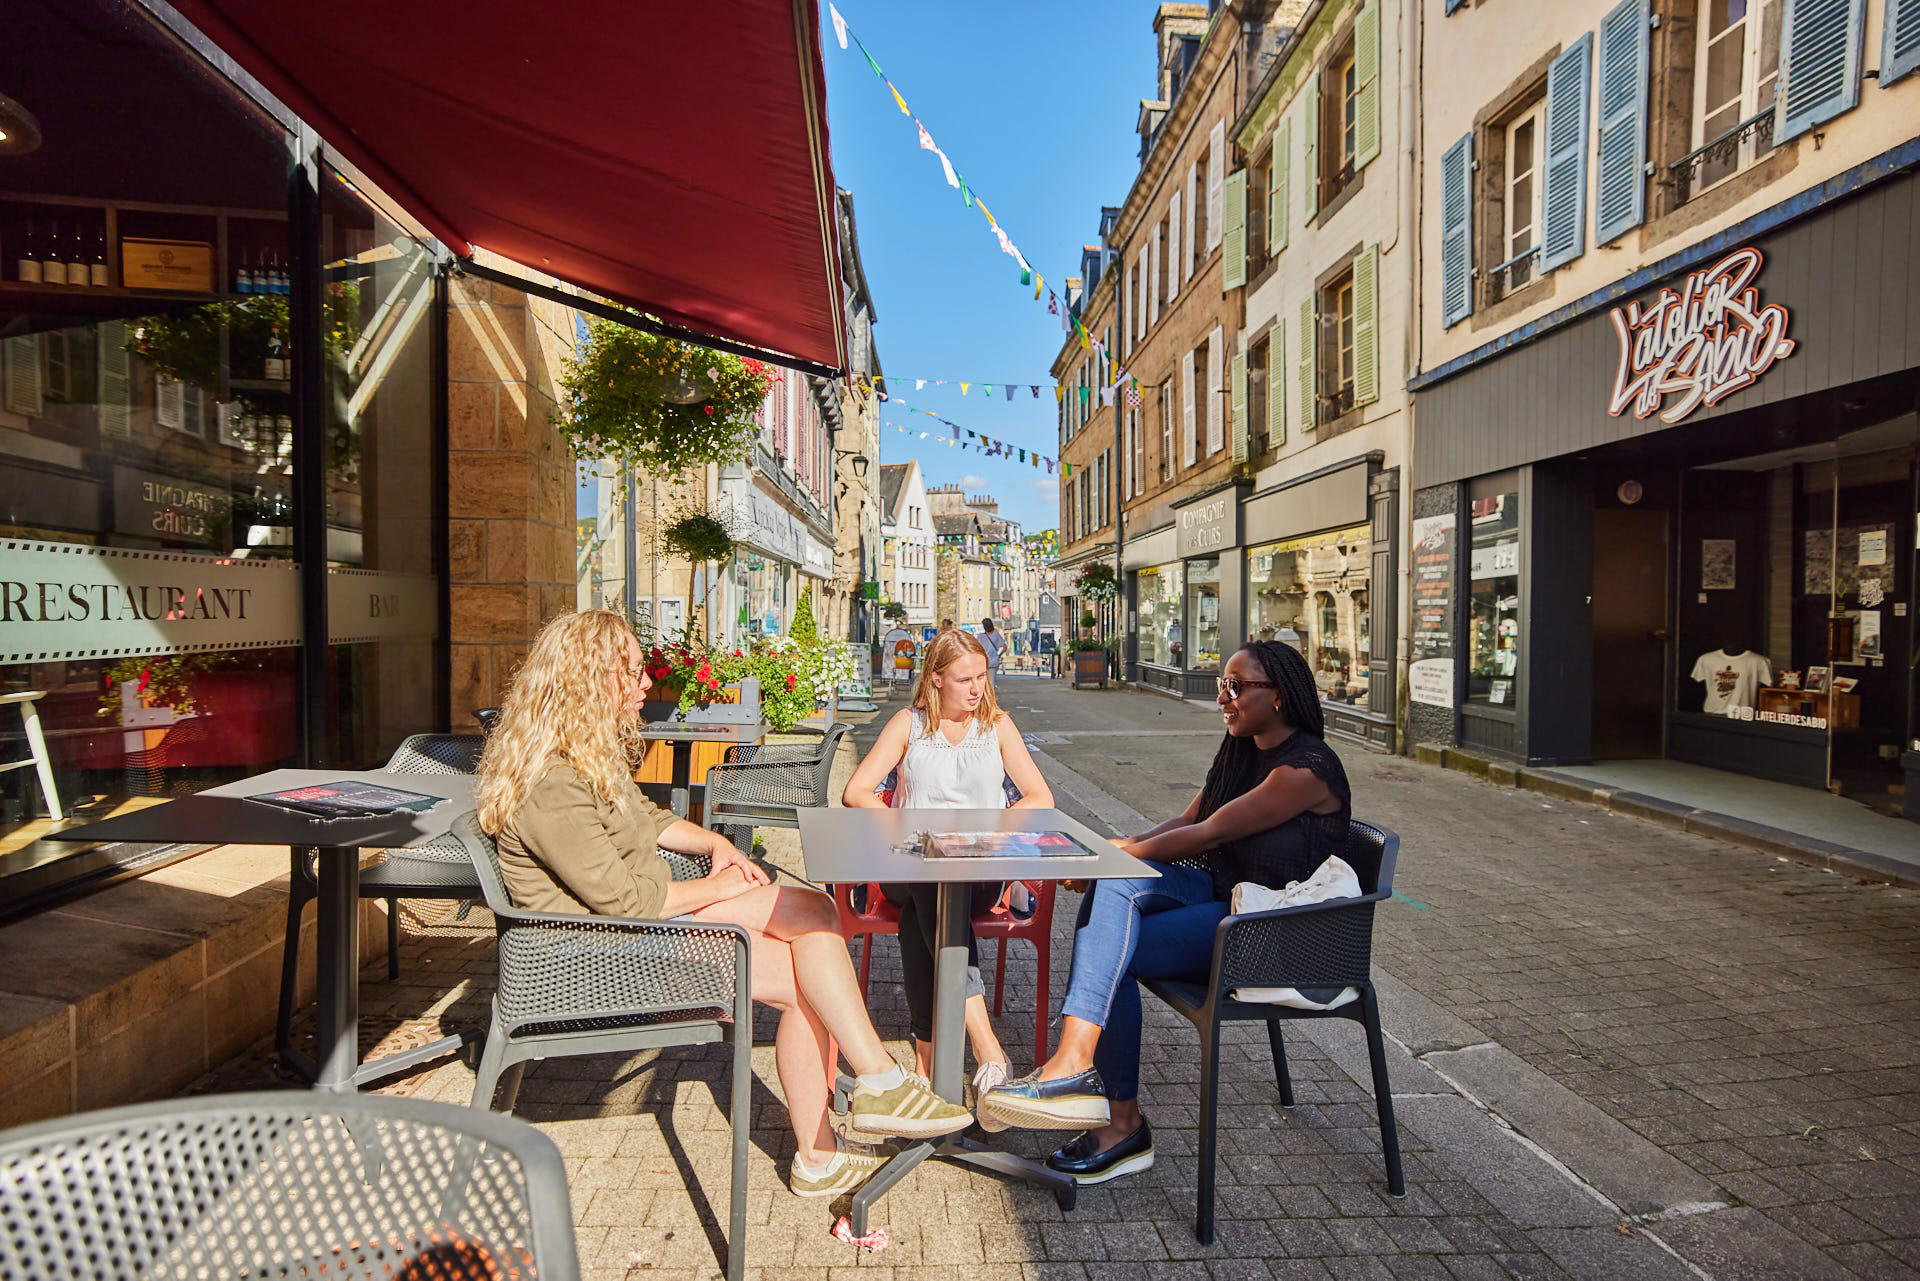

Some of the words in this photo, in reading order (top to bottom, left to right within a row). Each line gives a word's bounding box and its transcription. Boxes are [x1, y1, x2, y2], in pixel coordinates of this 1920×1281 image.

[1183, 500, 1225, 529] COMPAGNIE
[1198, 526, 1221, 548] CUIRS
[0, 581, 251, 621] RESTAURANT
[369, 594, 400, 617] BAR
[1585, 596, 1592, 604] 7
[1755, 710, 1827, 729] LATELIERDESABIO
